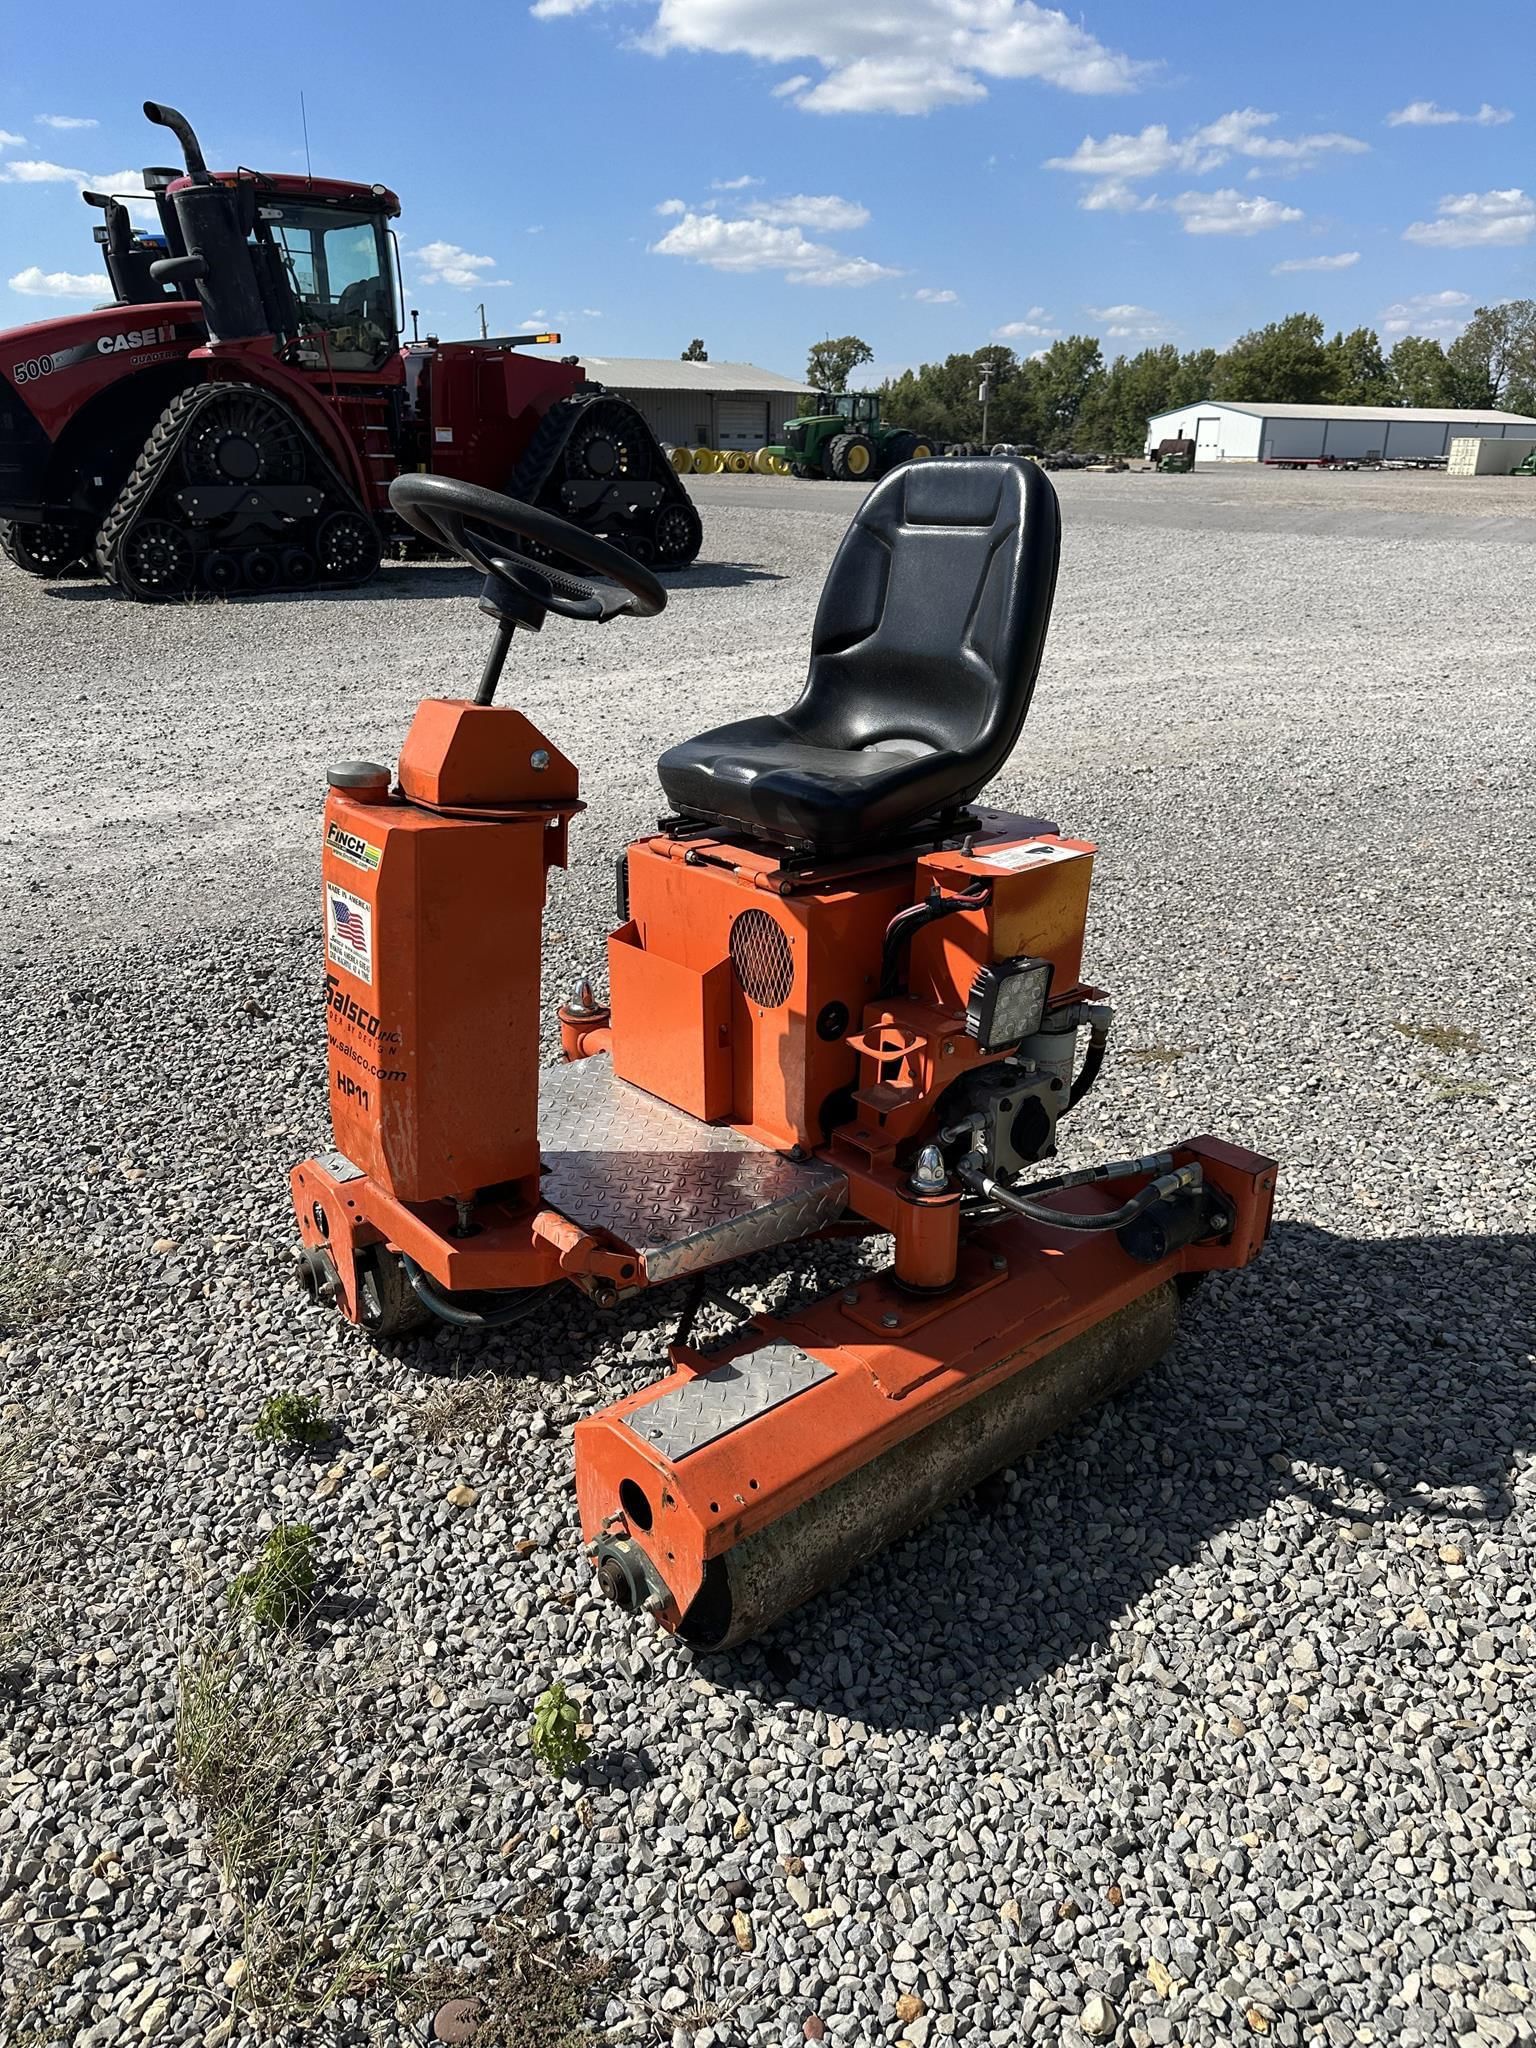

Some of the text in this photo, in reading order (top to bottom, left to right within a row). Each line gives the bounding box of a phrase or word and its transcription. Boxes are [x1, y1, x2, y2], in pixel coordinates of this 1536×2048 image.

[97, 329, 157, 355] CASE
[13, 354, 54, 385] 500
[327, 821, 367, 855] FINCH
[327, 883, 341, 896] MADE
[341, 890, 348, 900] IN
[326, 973, 380, 1037] Salsco
[347, 1022, 355, 1034] BY
[358, 1032, 397, 1055] DESIGN
[328, 1033, 407, 1082] w.salsco.com
[337, 1070, 369, 1112] HP11
